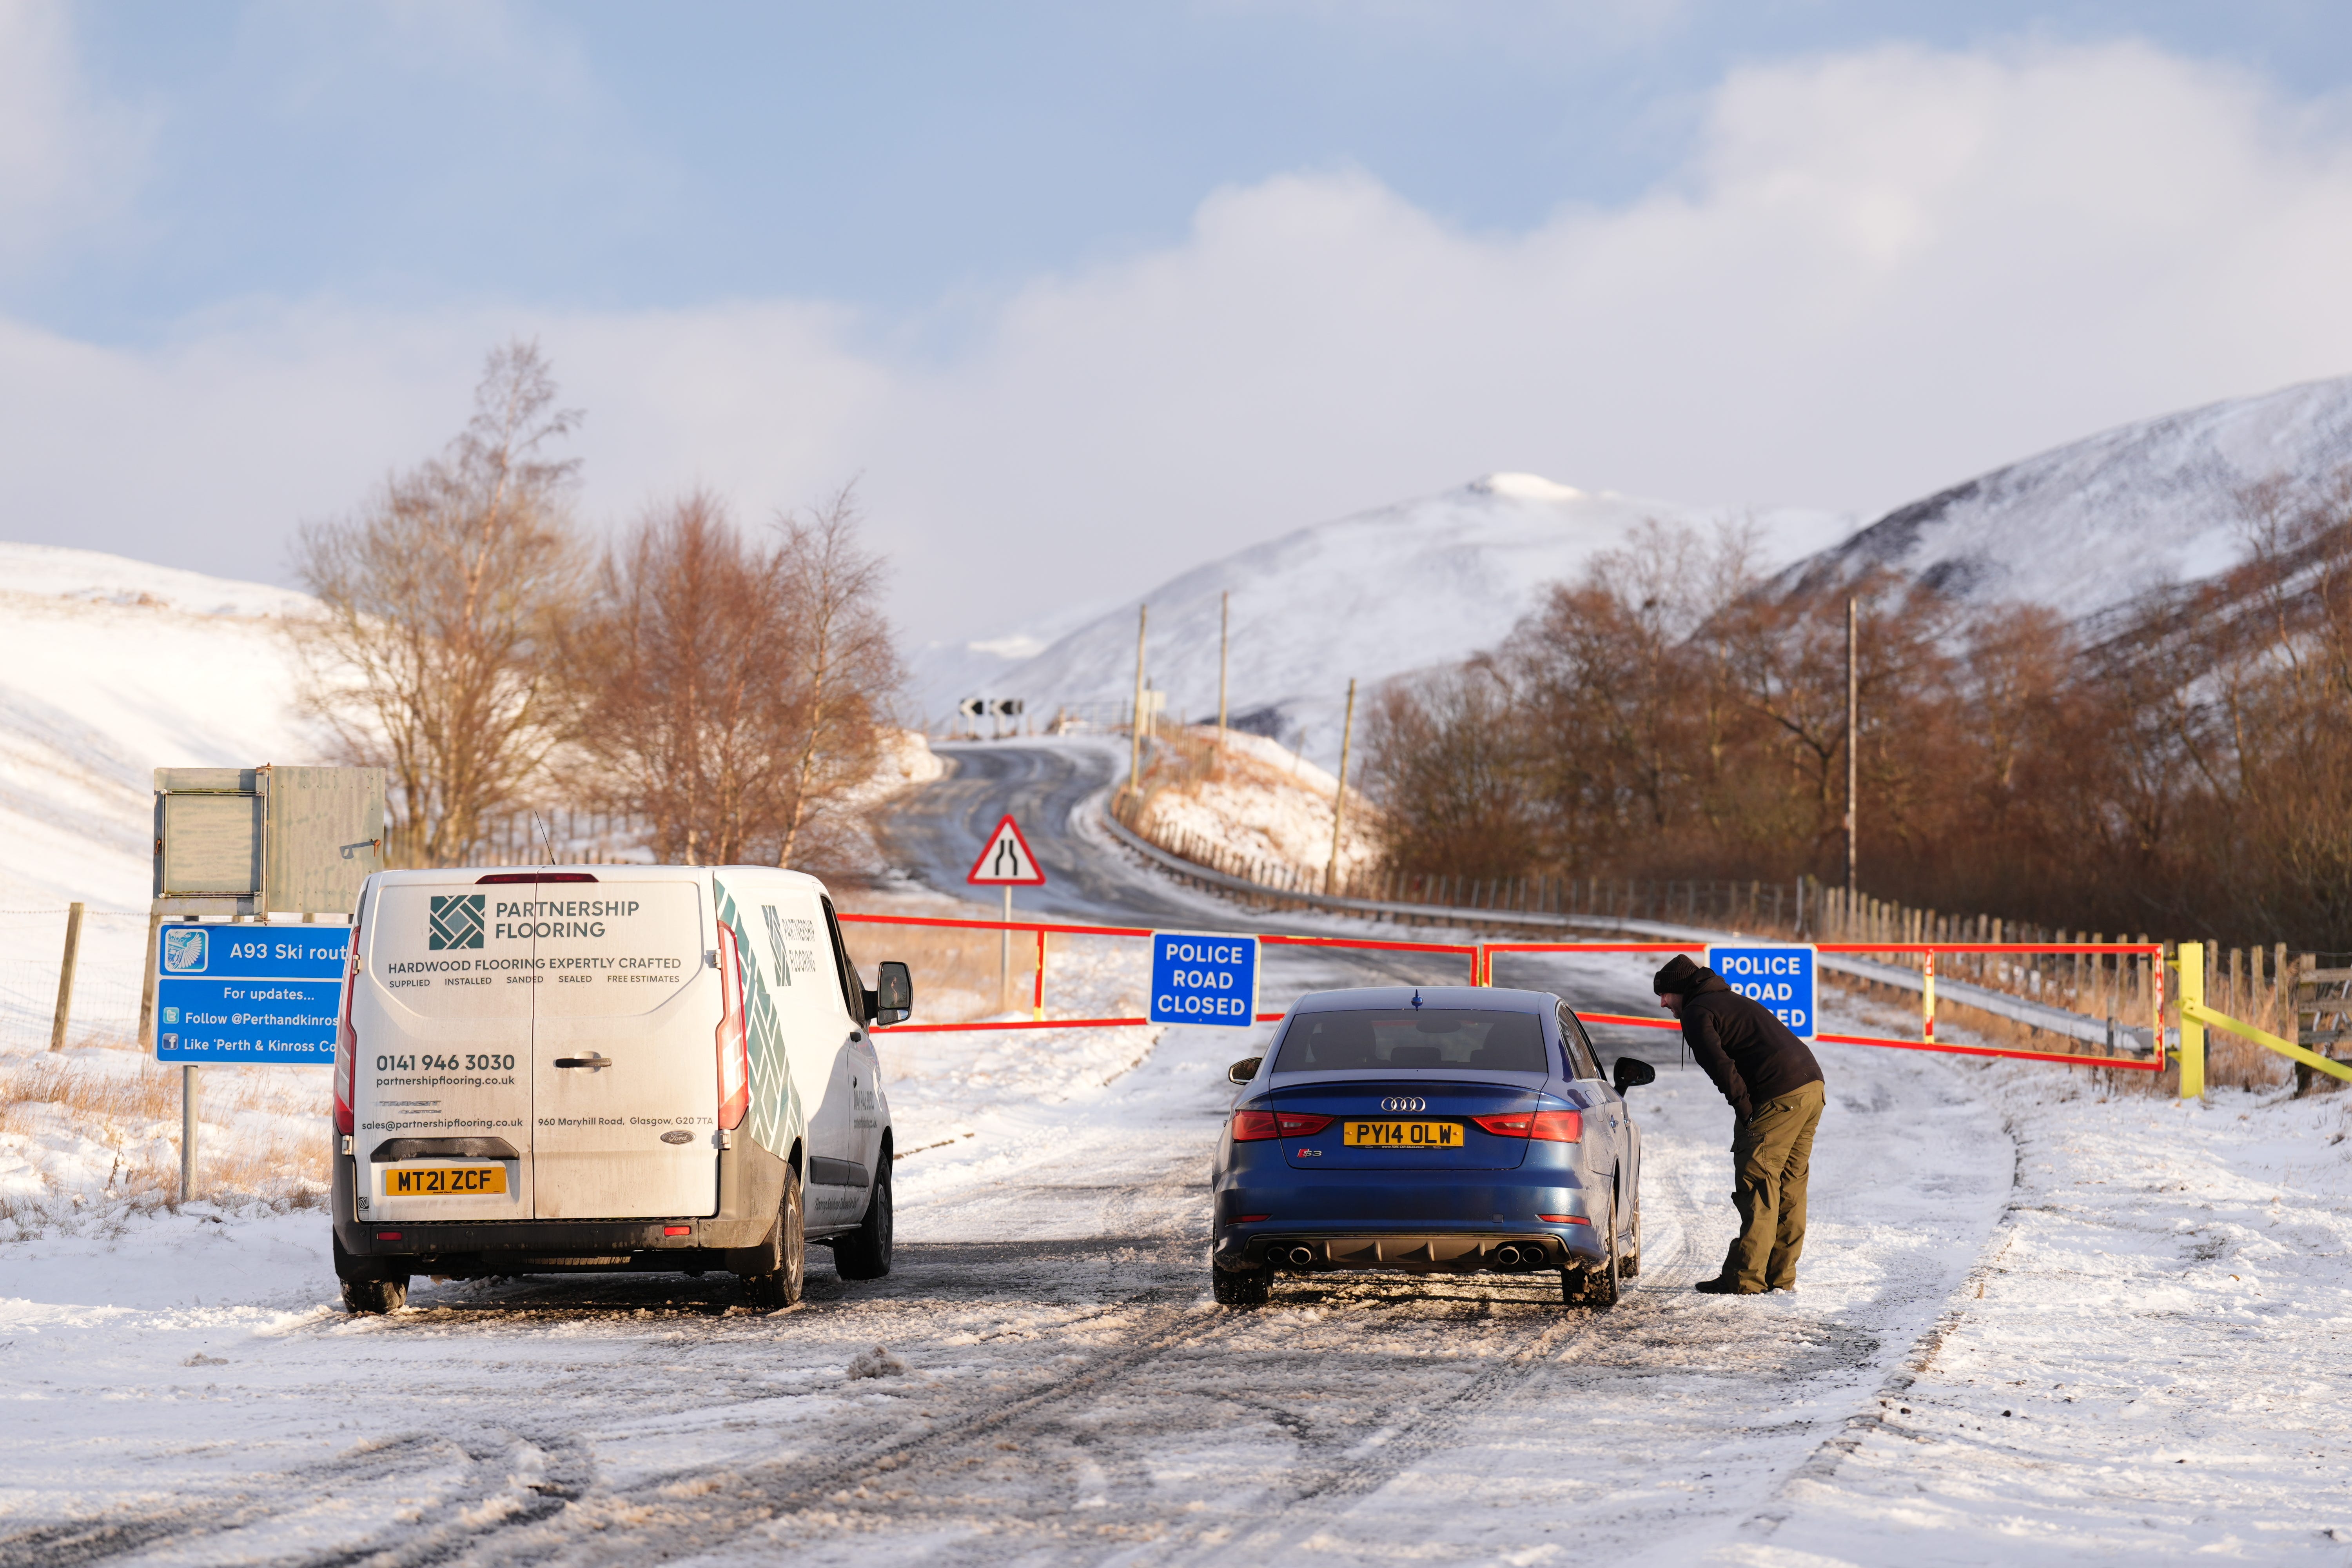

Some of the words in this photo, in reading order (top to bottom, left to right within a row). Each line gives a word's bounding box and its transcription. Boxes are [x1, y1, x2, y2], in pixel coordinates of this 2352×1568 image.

[496, 901, 639, 917] PARTNERSHIP
[496, 922, 605, 938] FLOORING
[782, 919, 815, 941] PARTNERSHIP
[230, 943, 267, 958] A93
[276, 944, 302, 959] Ski
[310, 946, 347, 960] rout
[1166, 944, 1243, 964] POLICE
[389, 961, 470, 974] HARDWOOD
[475, 959, 545, 970] FLOORING
[550, 958, 615, 968] EXPERTLY
[619, 958, 681, 968] CRAFTED
[789, 950, 815, 972] FLOORING
[1722, 956, 1801, 975] POLICE
[390, 979, 430, 987] SUPPLIED
[1173, 970, 1233, 989] ROAD
[224, 987, 245, 999] For
[250, 988, 314, 1001] updates...
[1158, 995, 1245, 1016] CLOSED
[185, 1013, 227, 1024] Follow
[232, 1013, 338, 1026] @Perthandkinros
[185, 1039, 209, 1050] Like
[255, 1040, 263, 1051] &
[269, 1040, 314, 1051] Kinross
[319, 1041, 336, 1052] Co
[377, 1055, 415, 1071] 0141
[422, 1055, 459, 1070] 946
[465, 1054, 514, 1070] 3030
[377, 1076, 514, 1087] partnershipflooring.co.uk
[362, 1118, 523, 1131] sales@partnershipflooring.co.uk
[558, 1118, 595, 1127] Maryhill
[599, 1118, 624, 1126] Road,
[630, 1117, 673, 1126] Glasgow,
[669, 1133, 688, 1141] Ford
[1357, 1125, 1403, 1143] PY14
[1411, 1125, 1451, 1143] OLW
[399, 1171, 444, 1191] MT21
[452, 1170, 492, 1190] ZCF
